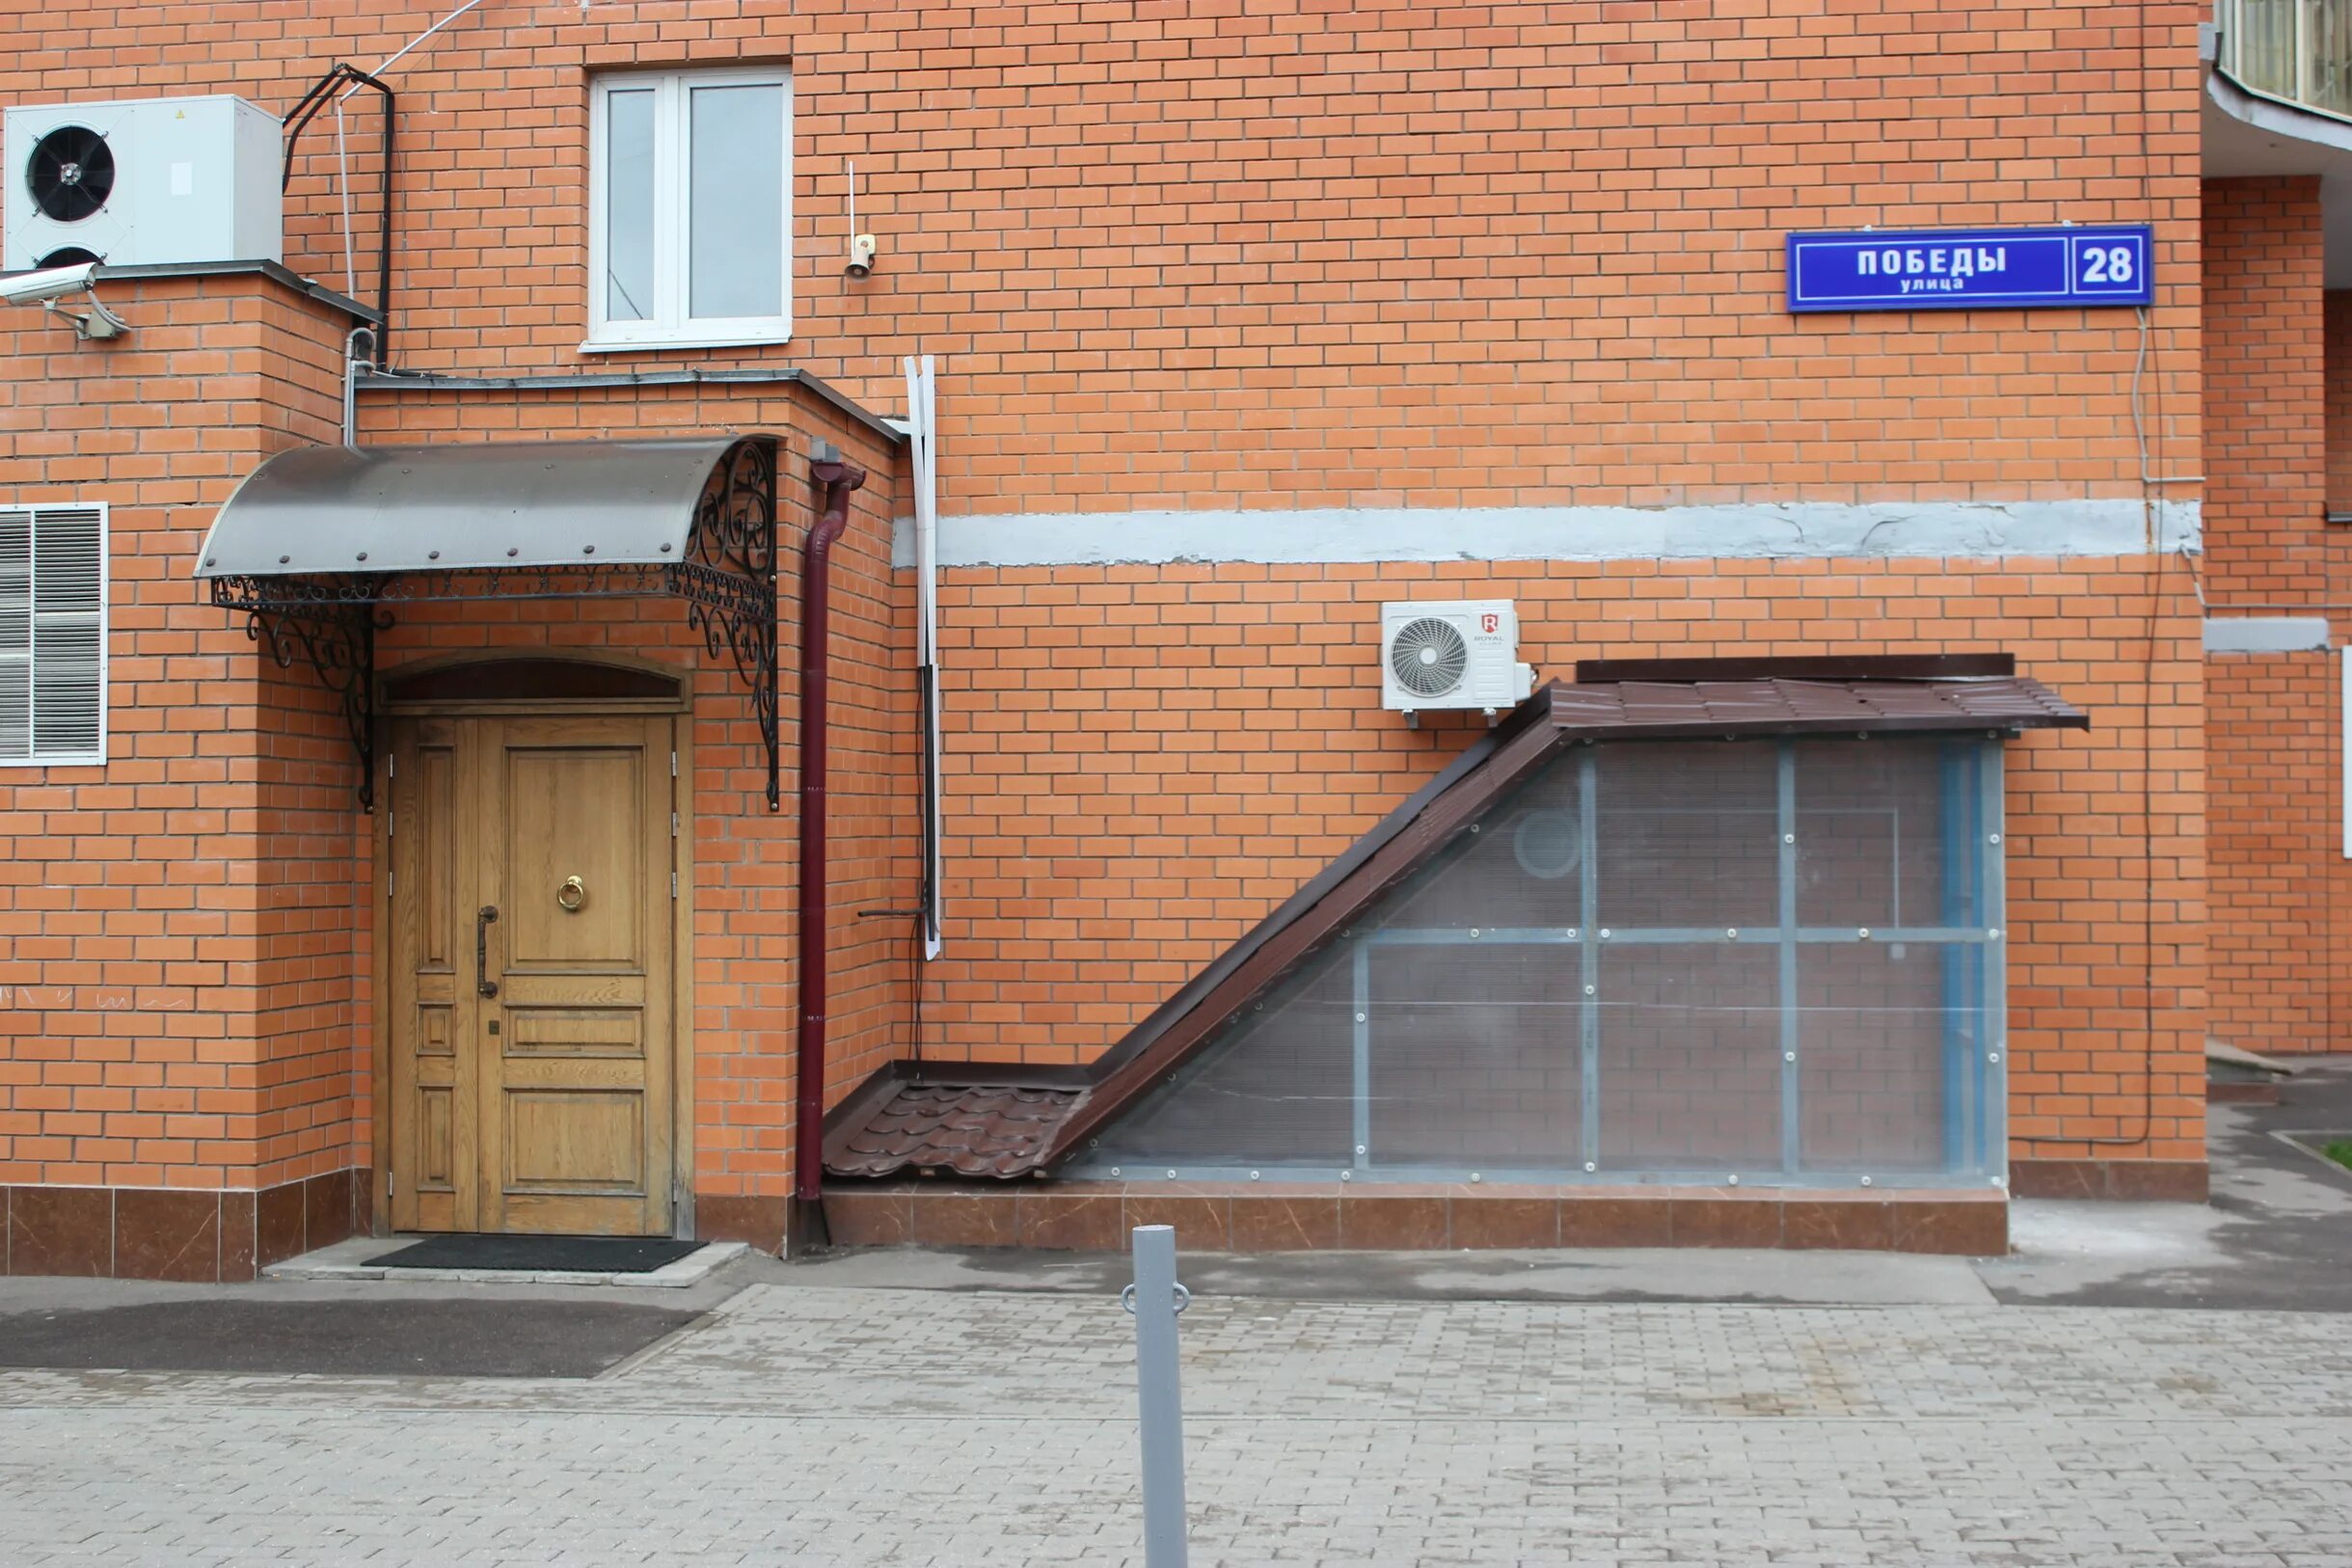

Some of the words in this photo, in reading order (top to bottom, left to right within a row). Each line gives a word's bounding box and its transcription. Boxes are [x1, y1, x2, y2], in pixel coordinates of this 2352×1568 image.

[1858, 247, 2006, 277] ПОБЕДЫ
[2082, 247, 2133, 283] 28
[1901, 277, 1963, 293] улица
